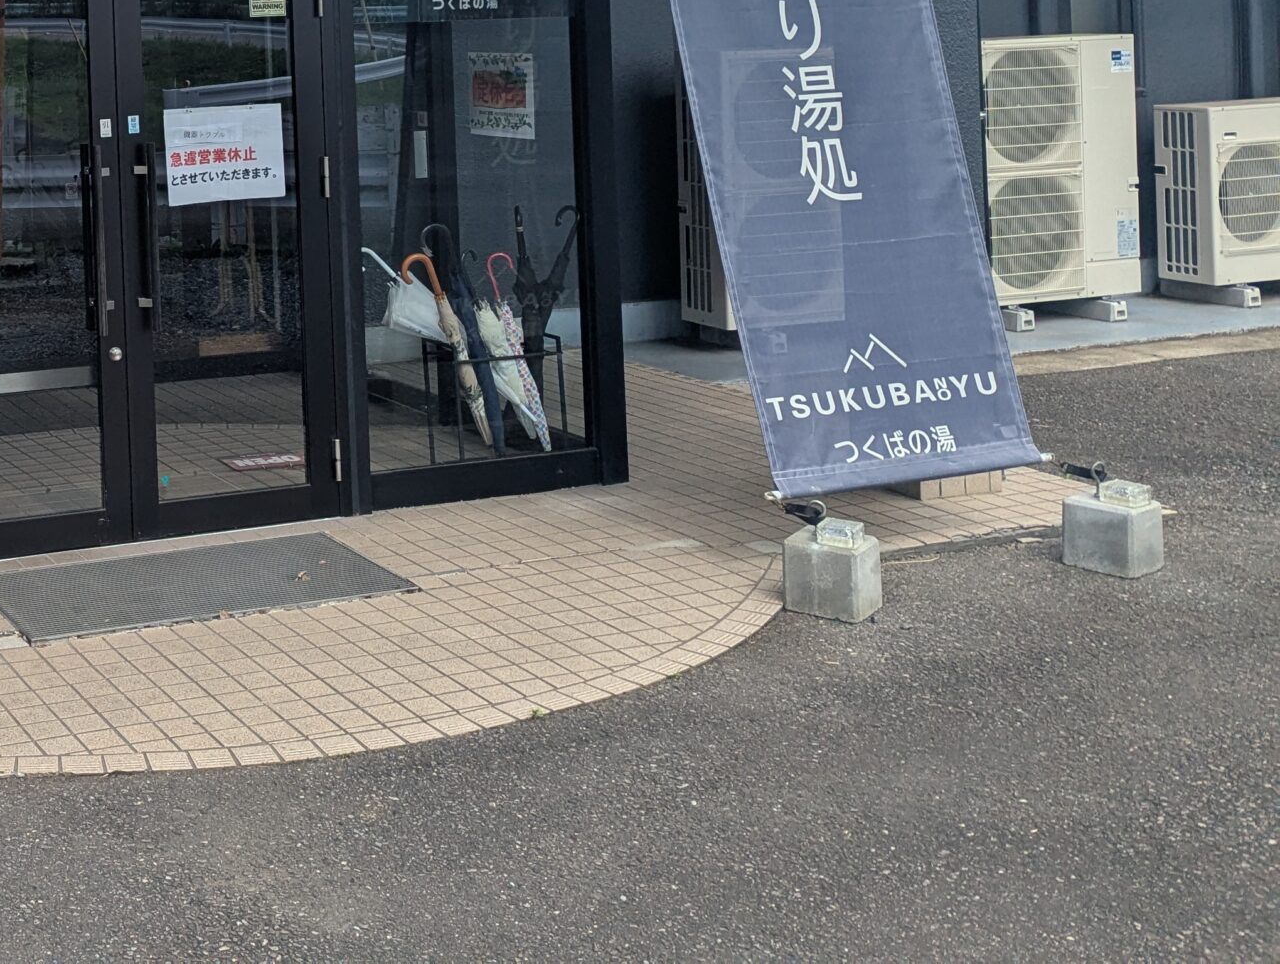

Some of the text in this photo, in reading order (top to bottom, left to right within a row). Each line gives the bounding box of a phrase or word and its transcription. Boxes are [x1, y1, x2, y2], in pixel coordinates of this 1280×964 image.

[170, 146, 257, 167] 急遽営業休止
[171, 167, 277, 186] とさせていただきます。
[834, 425, 957, 463] つくばの湯
[233, 455, 300, 466] OPEN
